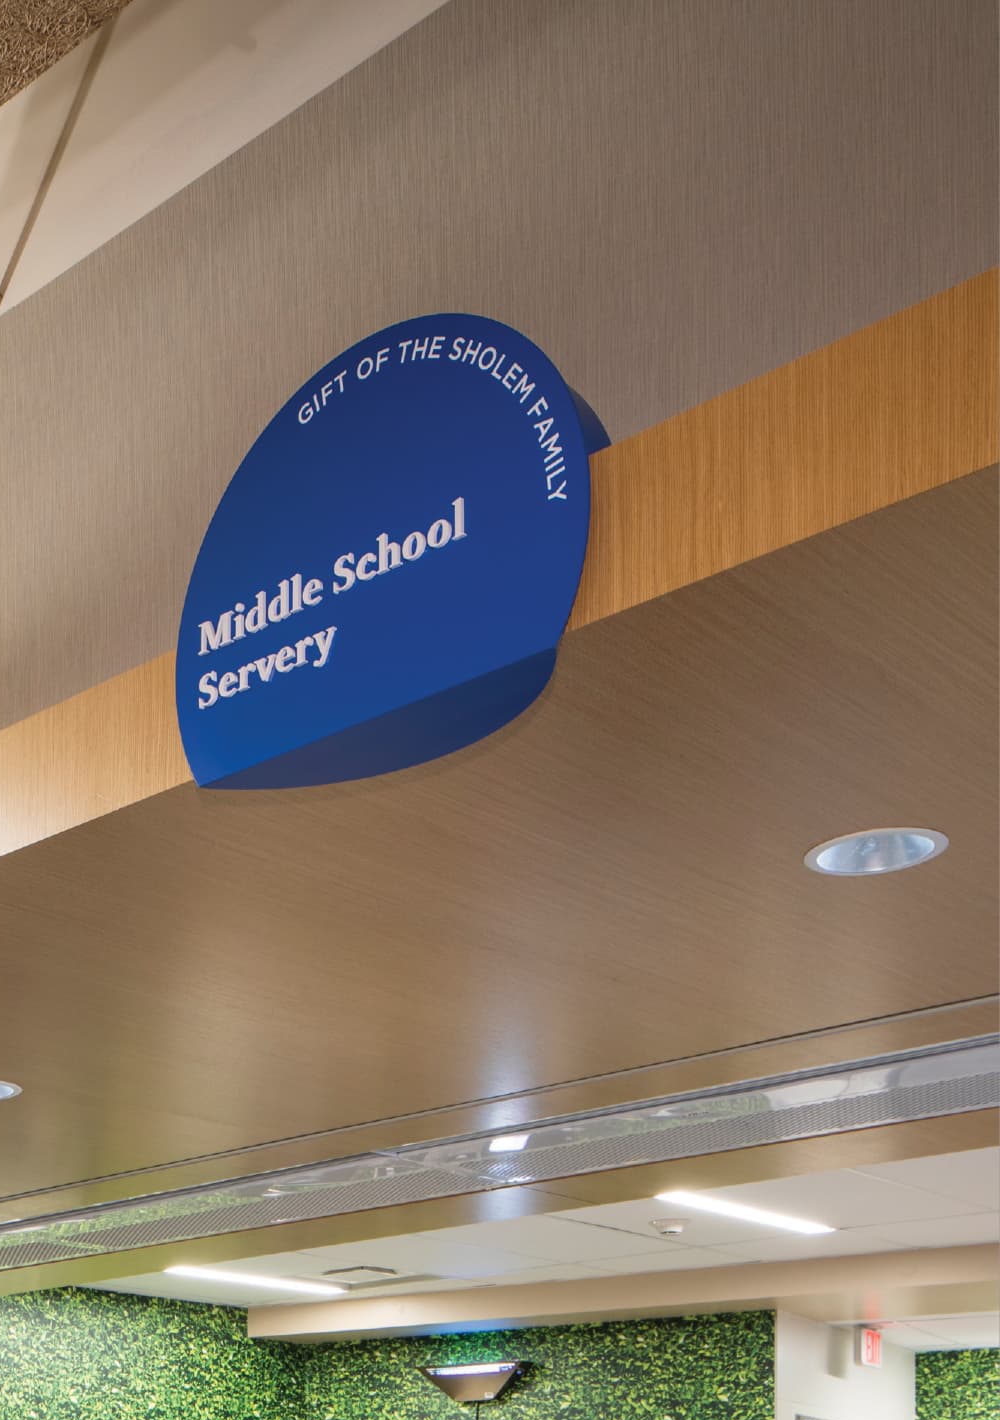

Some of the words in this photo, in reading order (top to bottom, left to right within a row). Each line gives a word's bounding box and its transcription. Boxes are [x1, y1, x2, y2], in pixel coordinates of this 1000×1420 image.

[298, 369, 348, 425] GIFT
[356, 347, 391, 380] OF
[398, 335, 447, 364] THE
[448, 335, 537, 404] SHOLEM
[526, 396, 568, 501] FAMILY
[197, 573, 324, 656] Middle
[332, 496, 468, 595] School
[198, 625, 338, 710] Servery
